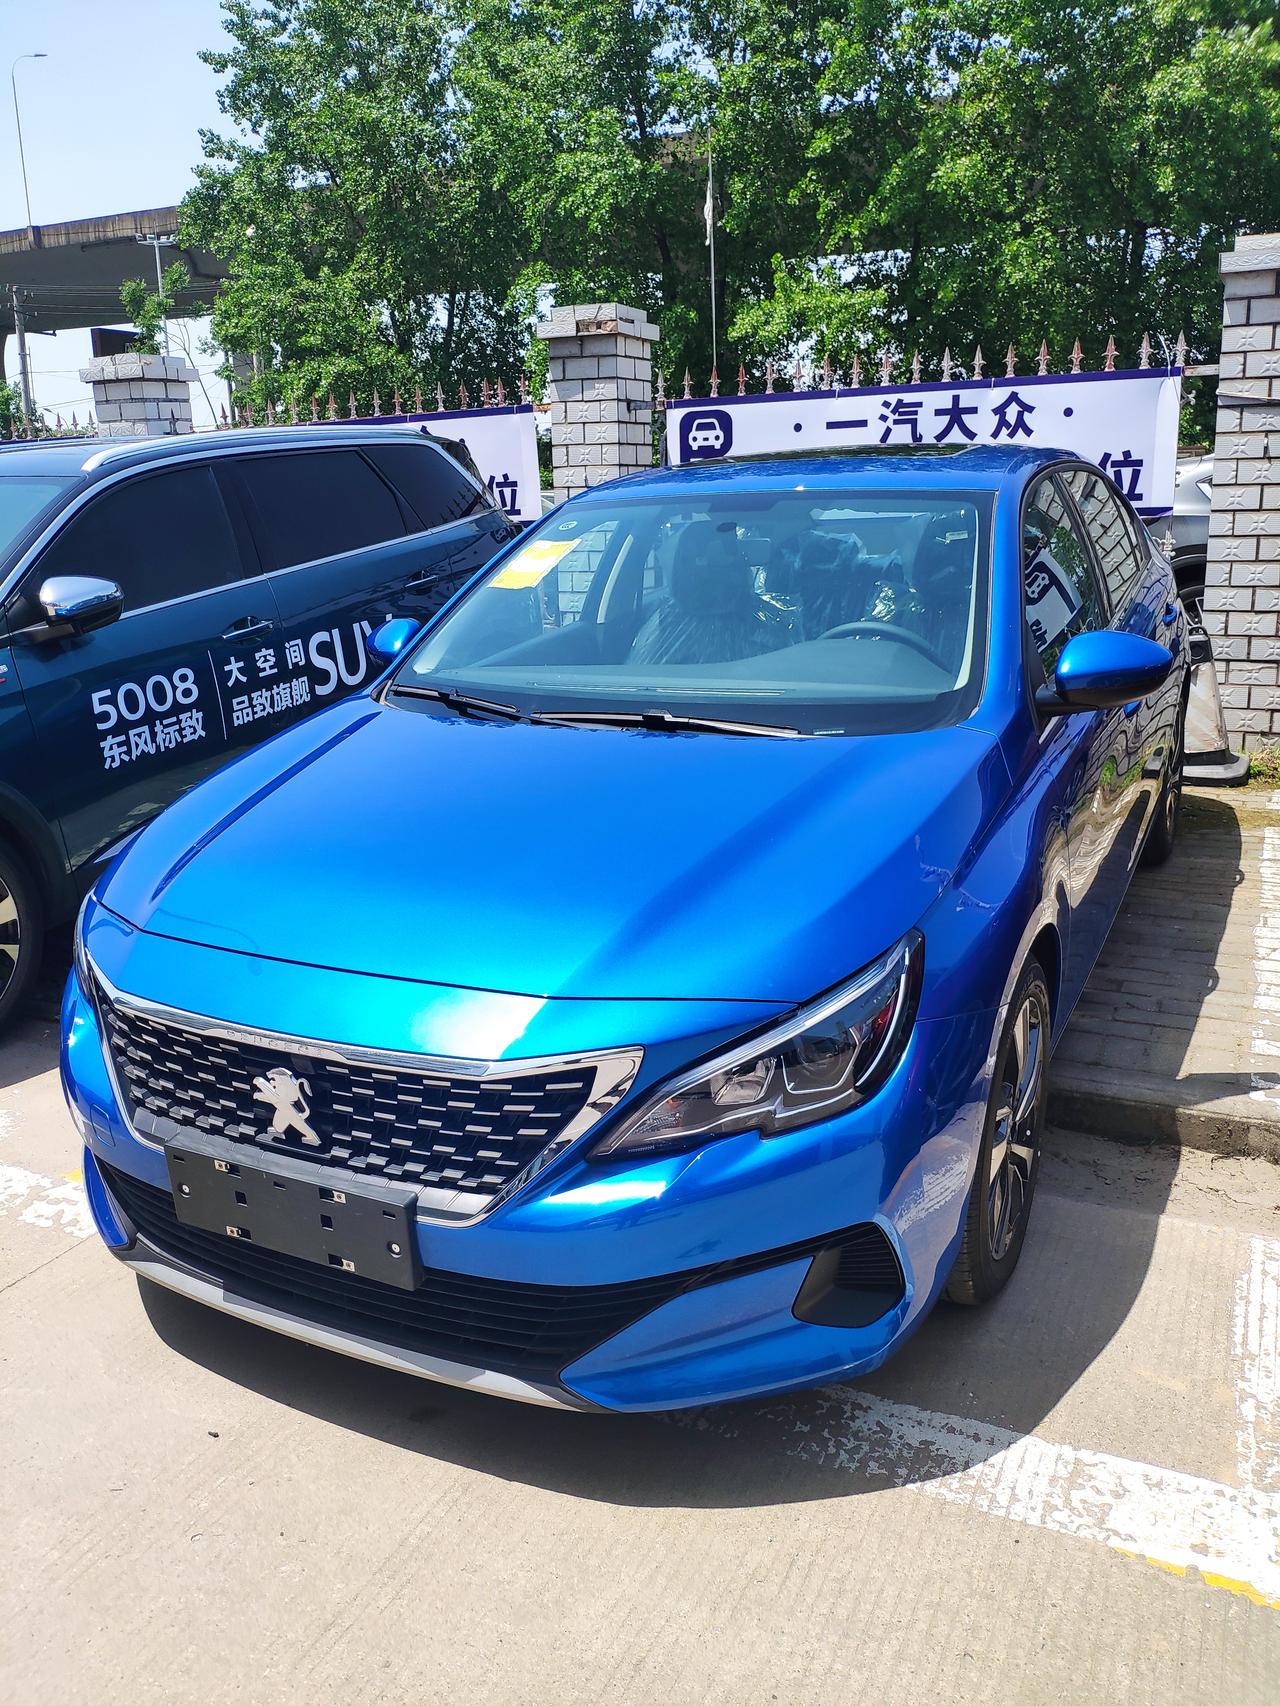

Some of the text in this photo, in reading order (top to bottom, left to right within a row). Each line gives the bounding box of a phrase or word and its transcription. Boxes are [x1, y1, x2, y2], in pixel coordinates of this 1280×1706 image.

[825, 390, 1036, 443] 一汽大众
[486, 473, 521, 516] 位
[1098, 449, 1143, 502] 位
[223, 638, 306, 688] 大空间
[91, 667, 199, 730] 5008
[232, 675, 311, 727] 品致旗舰
[100, 708, 206, 770] 东风标致
